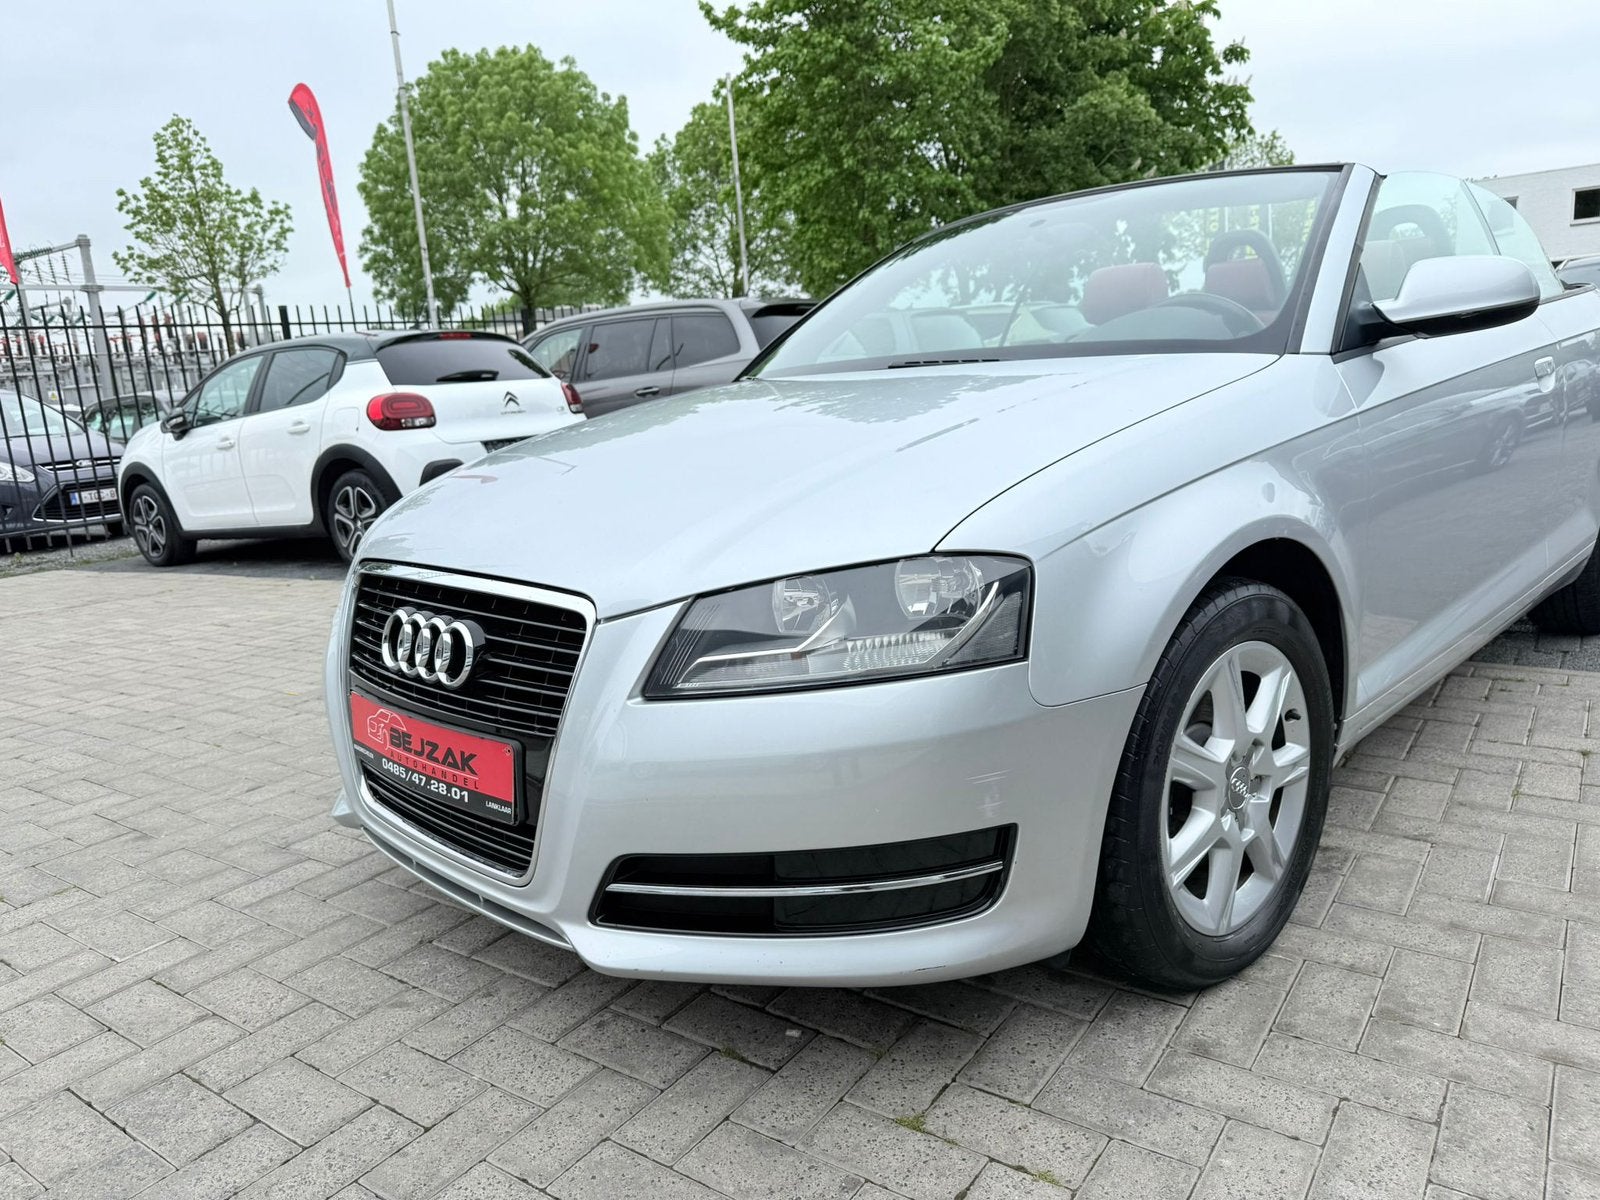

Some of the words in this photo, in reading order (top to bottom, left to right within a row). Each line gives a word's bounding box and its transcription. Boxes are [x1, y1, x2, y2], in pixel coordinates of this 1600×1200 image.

[389, 727, 478, 775] BEJZAK
[390, 751, 480, 790] AUTOHANDEL
[382, 758, 469, 803] 0485/47.28.01
